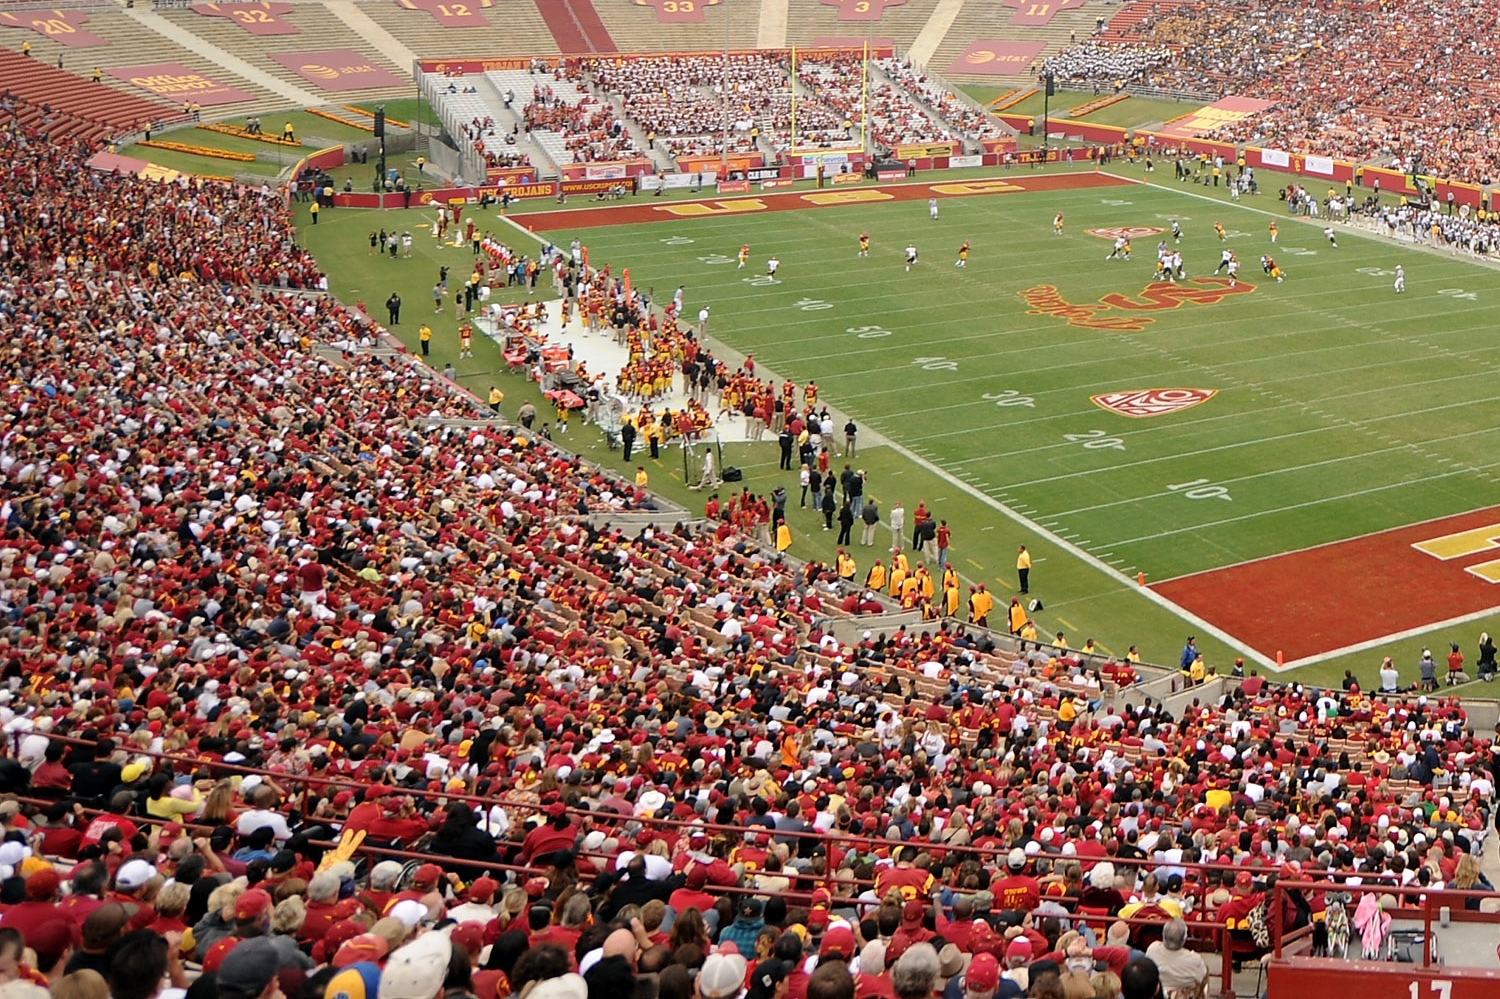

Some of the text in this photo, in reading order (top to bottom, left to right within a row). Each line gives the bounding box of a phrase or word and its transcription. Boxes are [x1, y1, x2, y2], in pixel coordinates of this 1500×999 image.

[437, 4, 472, 17] 12
[664, 1, 695, 13] 33
[855, 2, 870, 13] 3
[1025, 4, 1050, 16] 11
[232, 9, 274, 24] 32
[33, 18, 75, 35] 20
[996, 54, 1028, 63] at&t
[339, 64, 376, 75] at&t
[130, 74, 205, 86] Office
[150, 80, 217, 93] DEPOT
[503, 185, 552, 199] TROJANS
[846, 325, 892, 339] 50
[912, 355, 950, 371] 40
[982, 390, 1028, 408] 30
[1062, 430, 1116, 450] 20
[1166, 477, 1220, 500] 10
